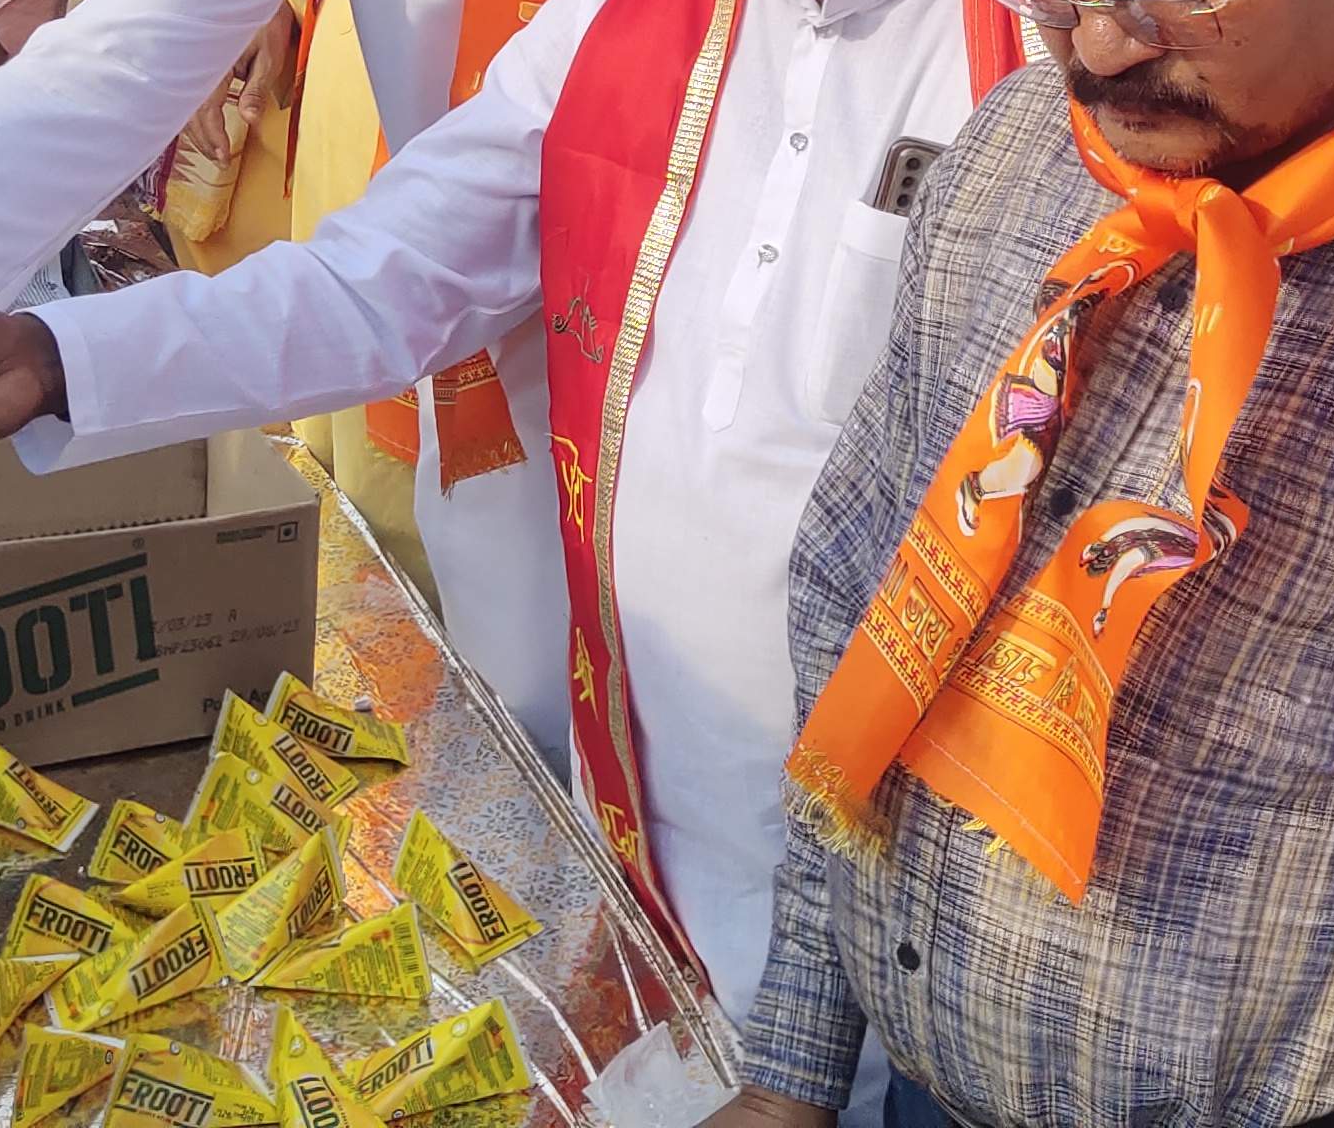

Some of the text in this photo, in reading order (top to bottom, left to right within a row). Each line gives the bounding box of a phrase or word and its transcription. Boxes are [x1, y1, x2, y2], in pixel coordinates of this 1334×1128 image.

[14, 698, 67, 727] DRINK
[279, 701, 355, 756] FROOTI
[272, 732, 336, 803] FROOTI
[184, 859, 258, 894] FROOTI
[450, 860, 507, 942] FROOTI
[25, 897, 114, 954] FROOTI
[130, 926, 210, 999] FROOTI
[357, 1036, 435, 1096] FROOTI
[119, 1073, 213, 1127] FROOTI
